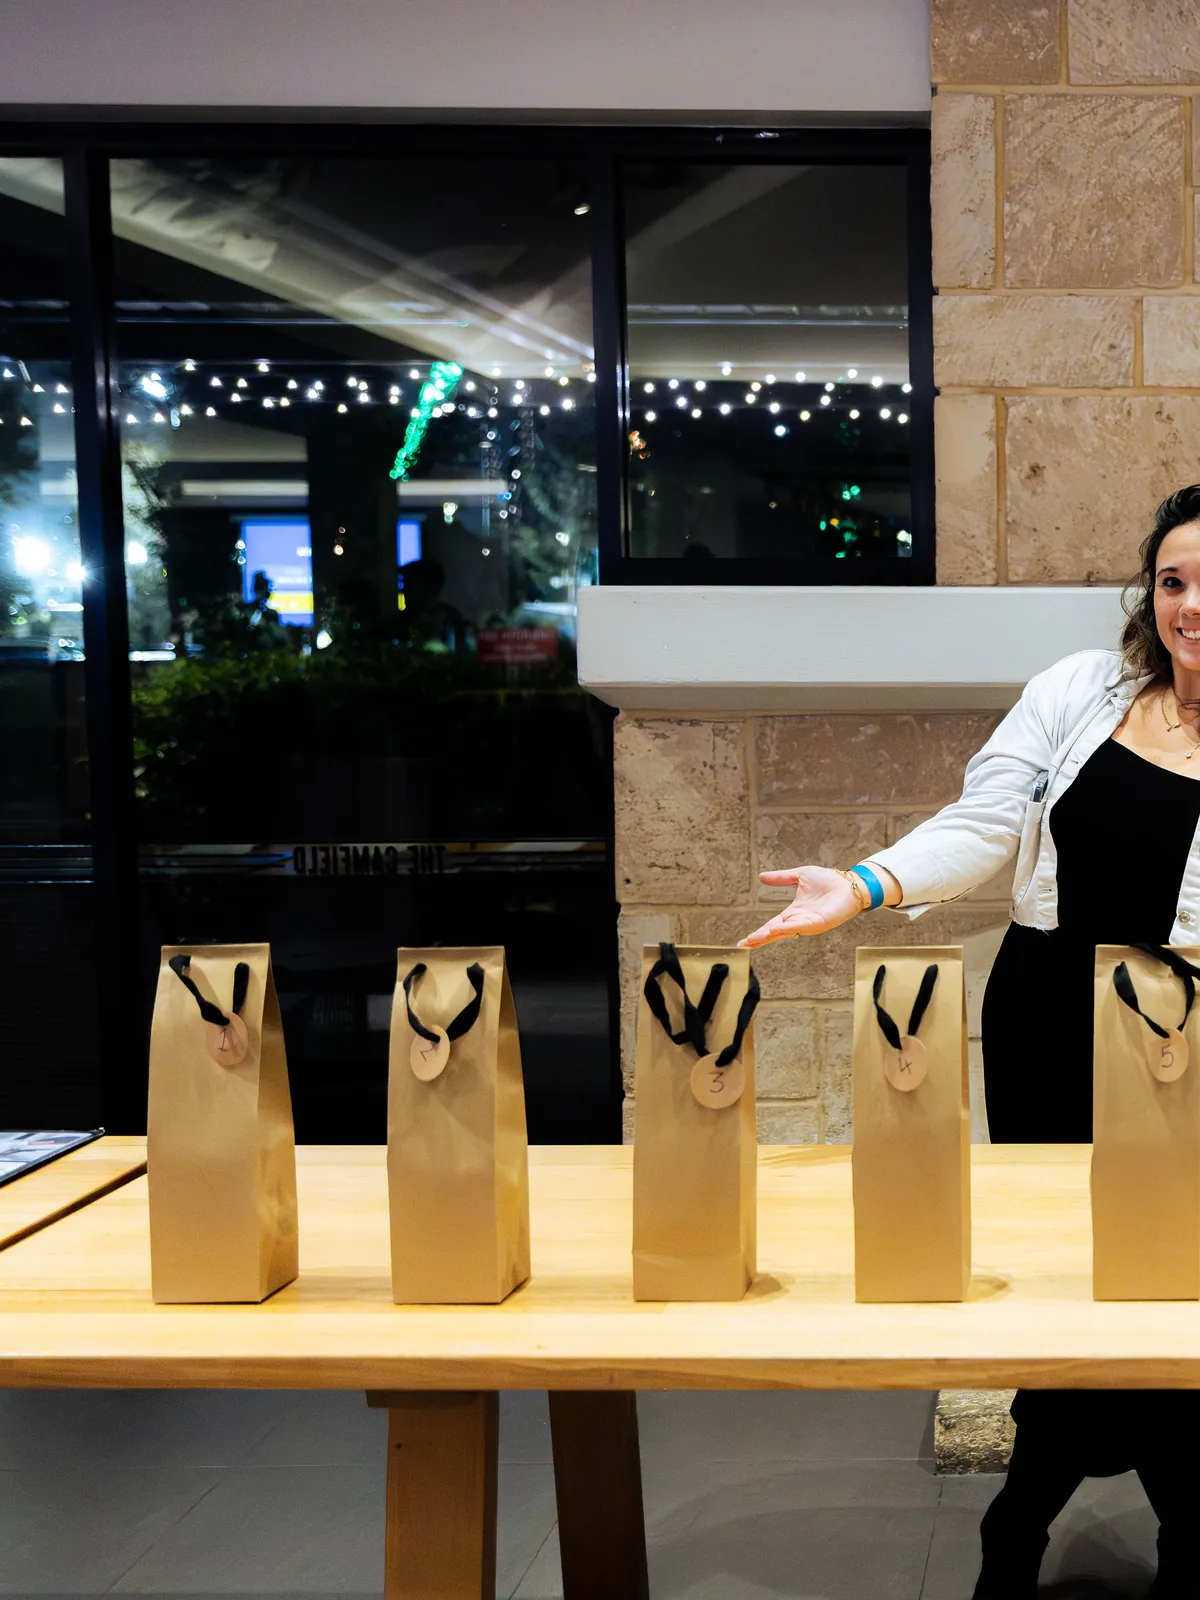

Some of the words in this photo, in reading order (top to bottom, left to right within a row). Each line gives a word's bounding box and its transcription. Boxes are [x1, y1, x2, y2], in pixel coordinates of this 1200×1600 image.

[217, 1028, 230, 1052] 1
[898, 1056, 913, 1075] 4
[1160, 1044, 1175, 1069] 5
[709, 1070, 725, 1094] 3
